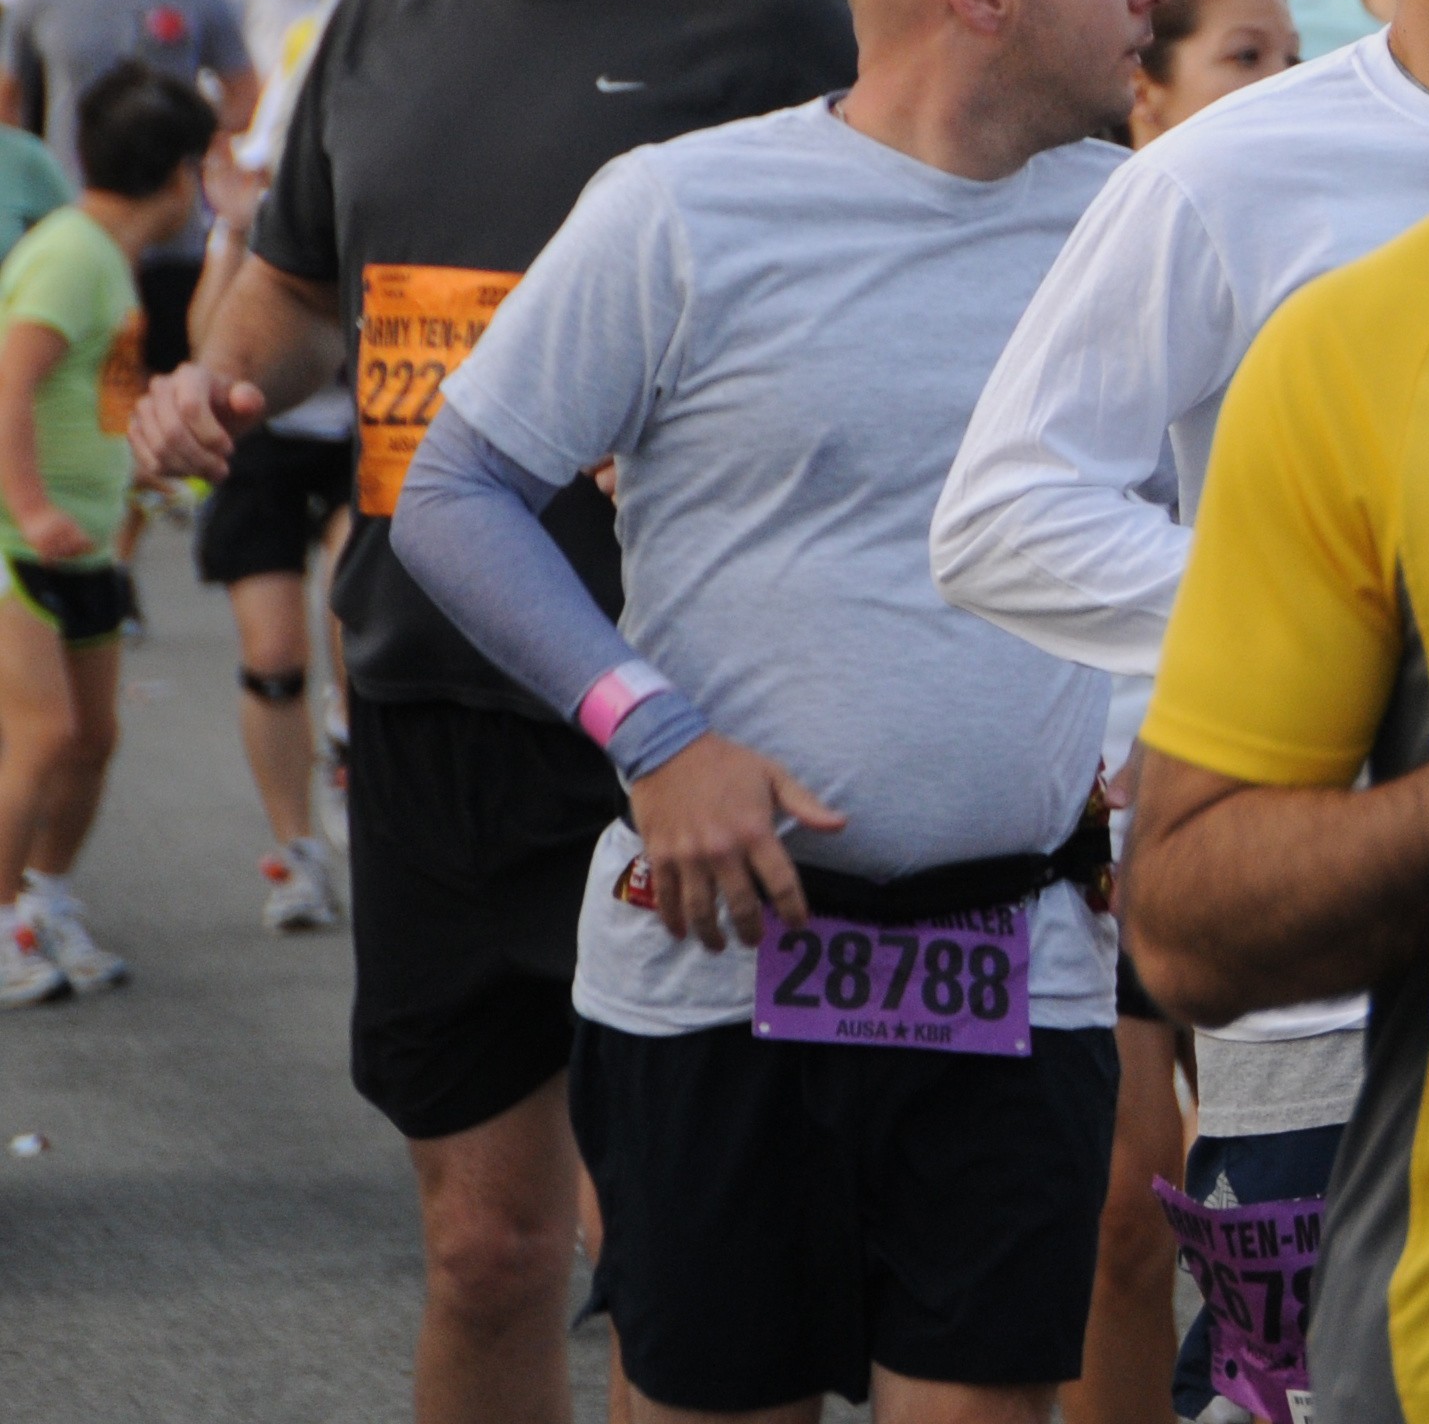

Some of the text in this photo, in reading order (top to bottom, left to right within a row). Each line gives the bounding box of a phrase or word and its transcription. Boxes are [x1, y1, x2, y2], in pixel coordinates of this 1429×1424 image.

[419, 317, 487, 349] TEN-M
[362, 359, 447, 425] 222
[773, 929, 1010, 1021] 28788
[837, 1020, 952, 1043] AUSA KBR
[1220, 1212, 1322, 1259] TEN-M
